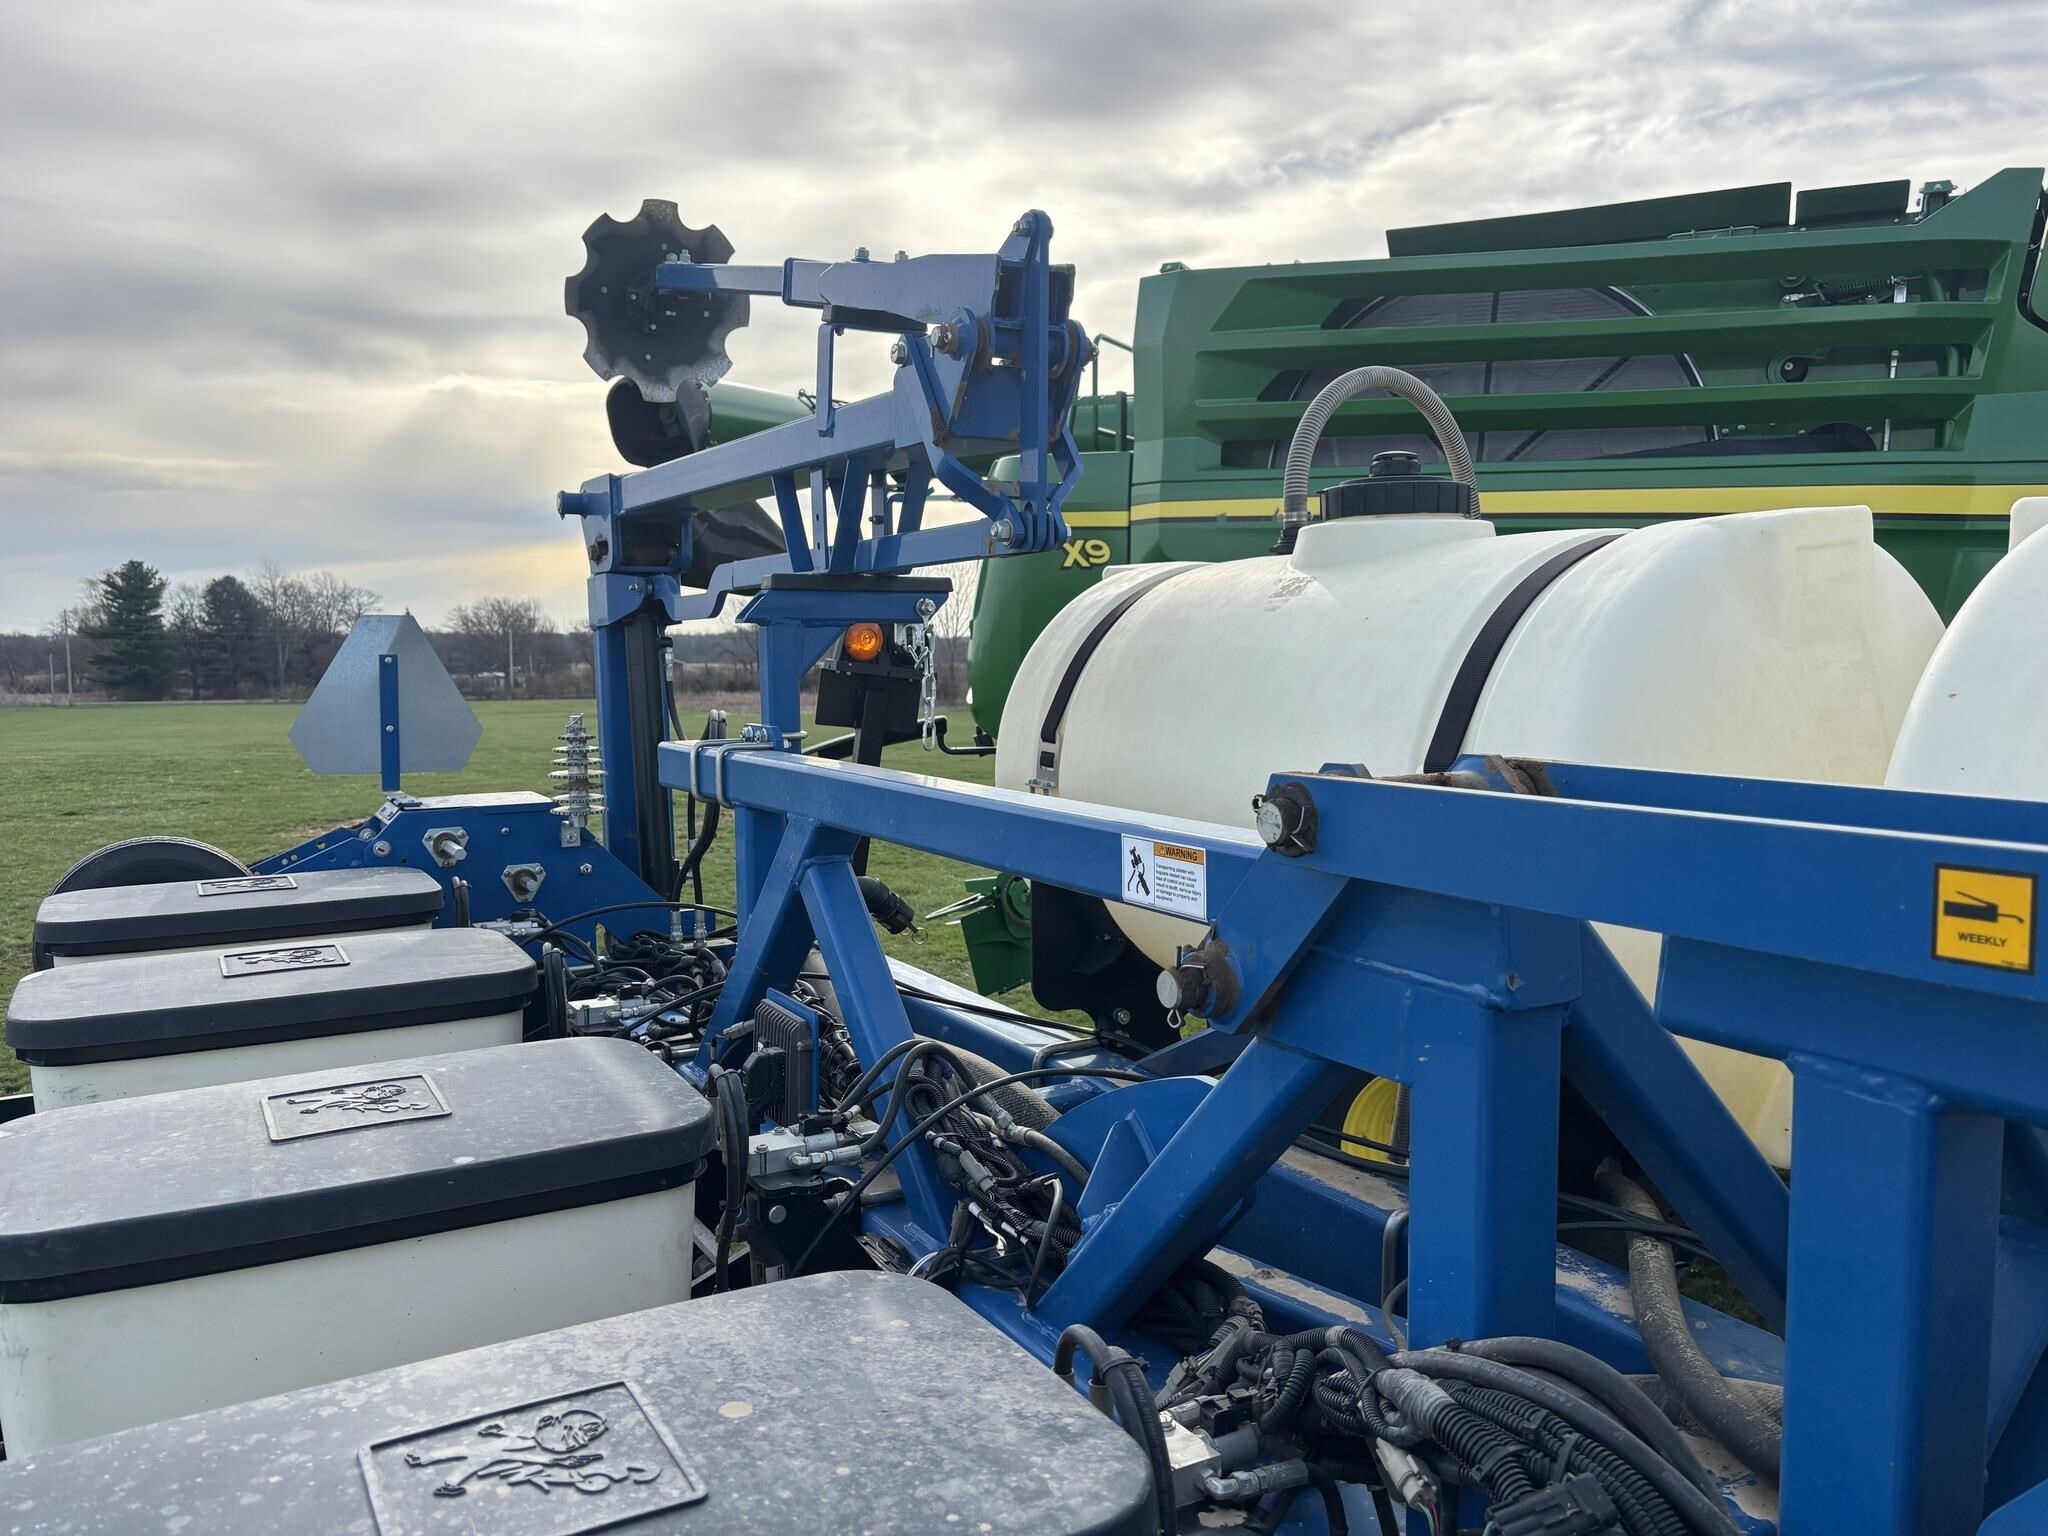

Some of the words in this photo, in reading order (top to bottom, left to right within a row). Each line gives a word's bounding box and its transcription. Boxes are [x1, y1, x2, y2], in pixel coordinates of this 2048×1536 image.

[1062, 539, 1112, 567] X9
[1165, 846, 1198, 861] WARNING
[1958, 931, 2008, 947] WEEKLY
